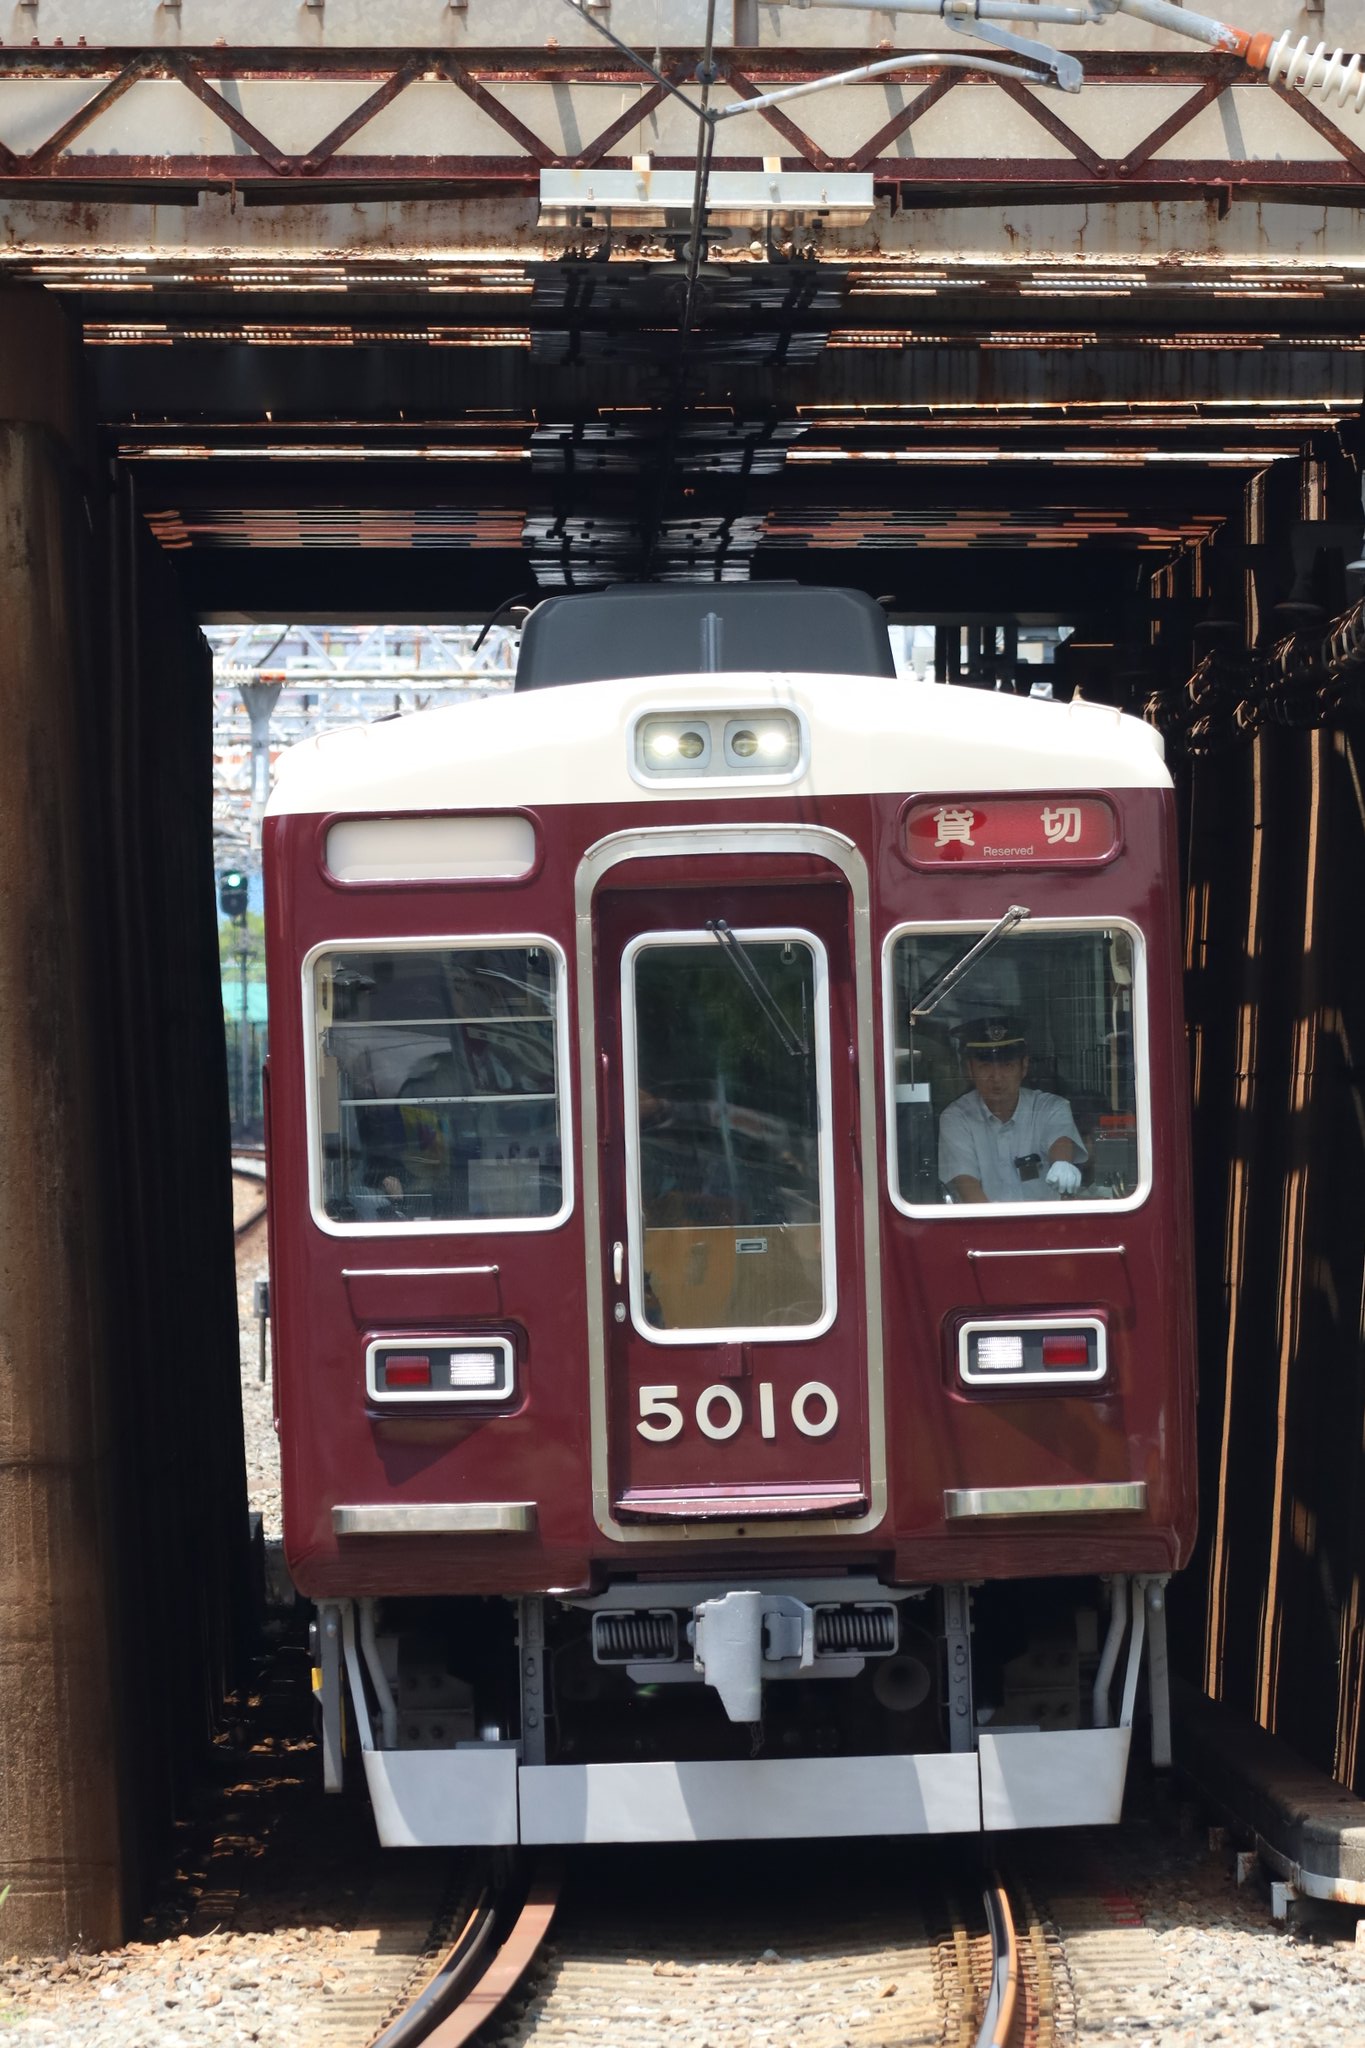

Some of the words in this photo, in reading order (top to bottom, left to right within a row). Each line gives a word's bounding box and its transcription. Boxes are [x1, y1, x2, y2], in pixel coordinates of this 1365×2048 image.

[933, 807, 1081, 847] 貸切
[983, 845, 1034, 857] Reserved
[636, 1381, 839, 1442] 5010
